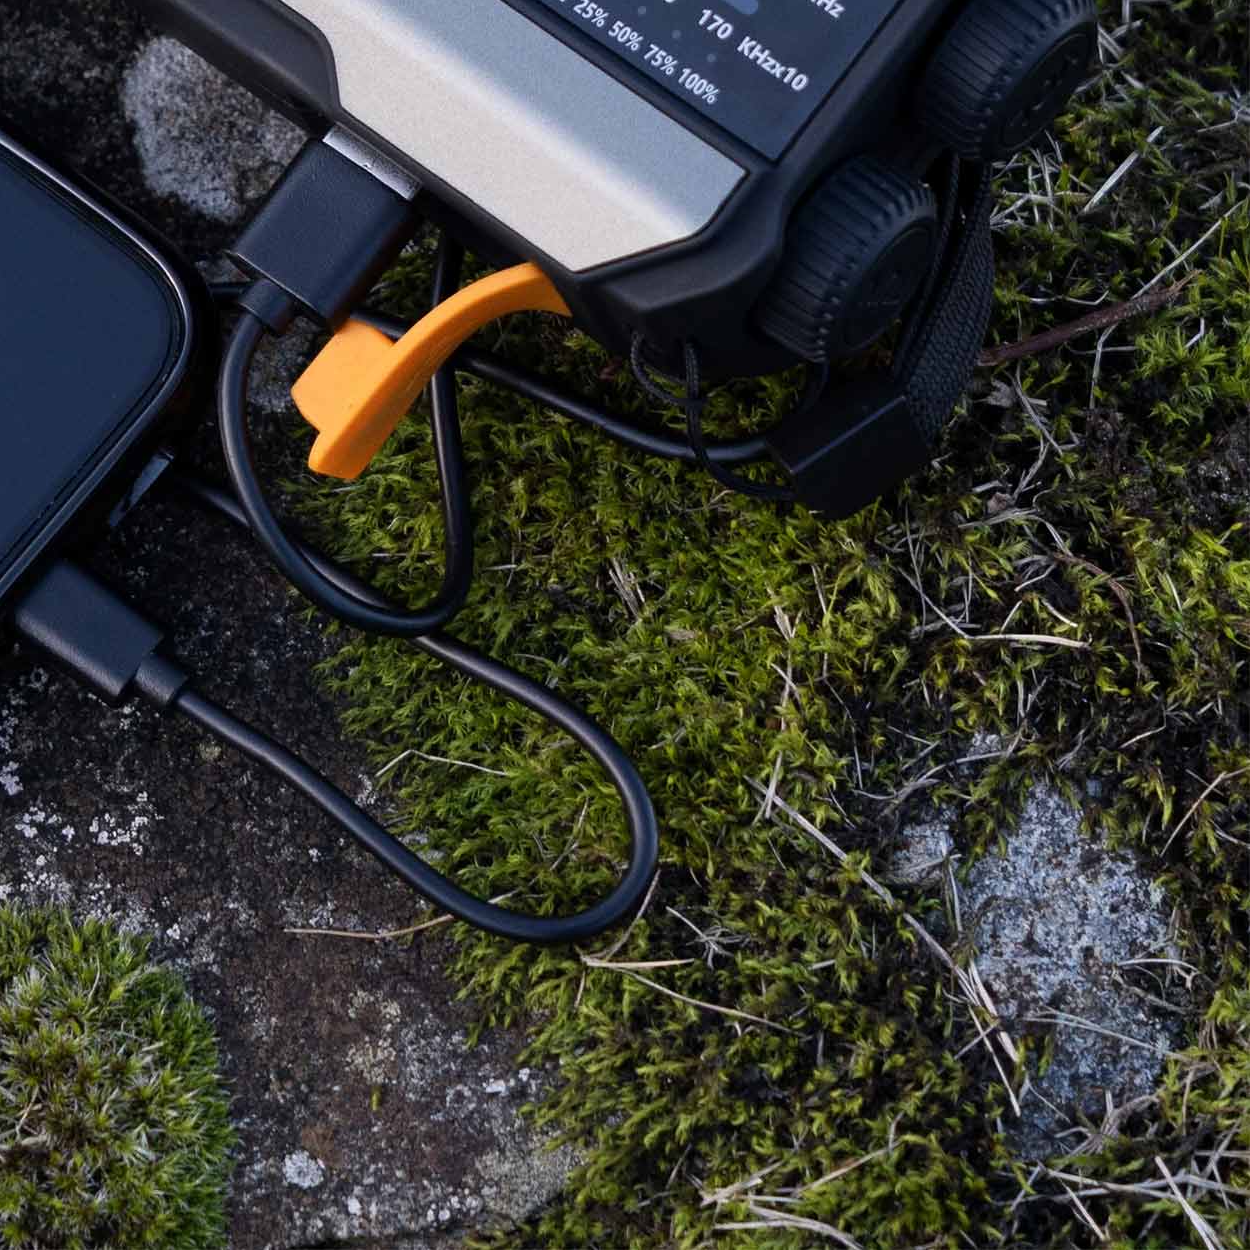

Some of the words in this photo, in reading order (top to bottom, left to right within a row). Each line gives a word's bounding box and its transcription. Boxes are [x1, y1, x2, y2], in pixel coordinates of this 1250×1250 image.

[608, 20, 644, 52] 50%
[643, 43, 679, 76] 75%
[677, 67, 720, 105] 100%
[698, 9, 734, 40] 170
[736, 35, 809, 92] KHzx10
